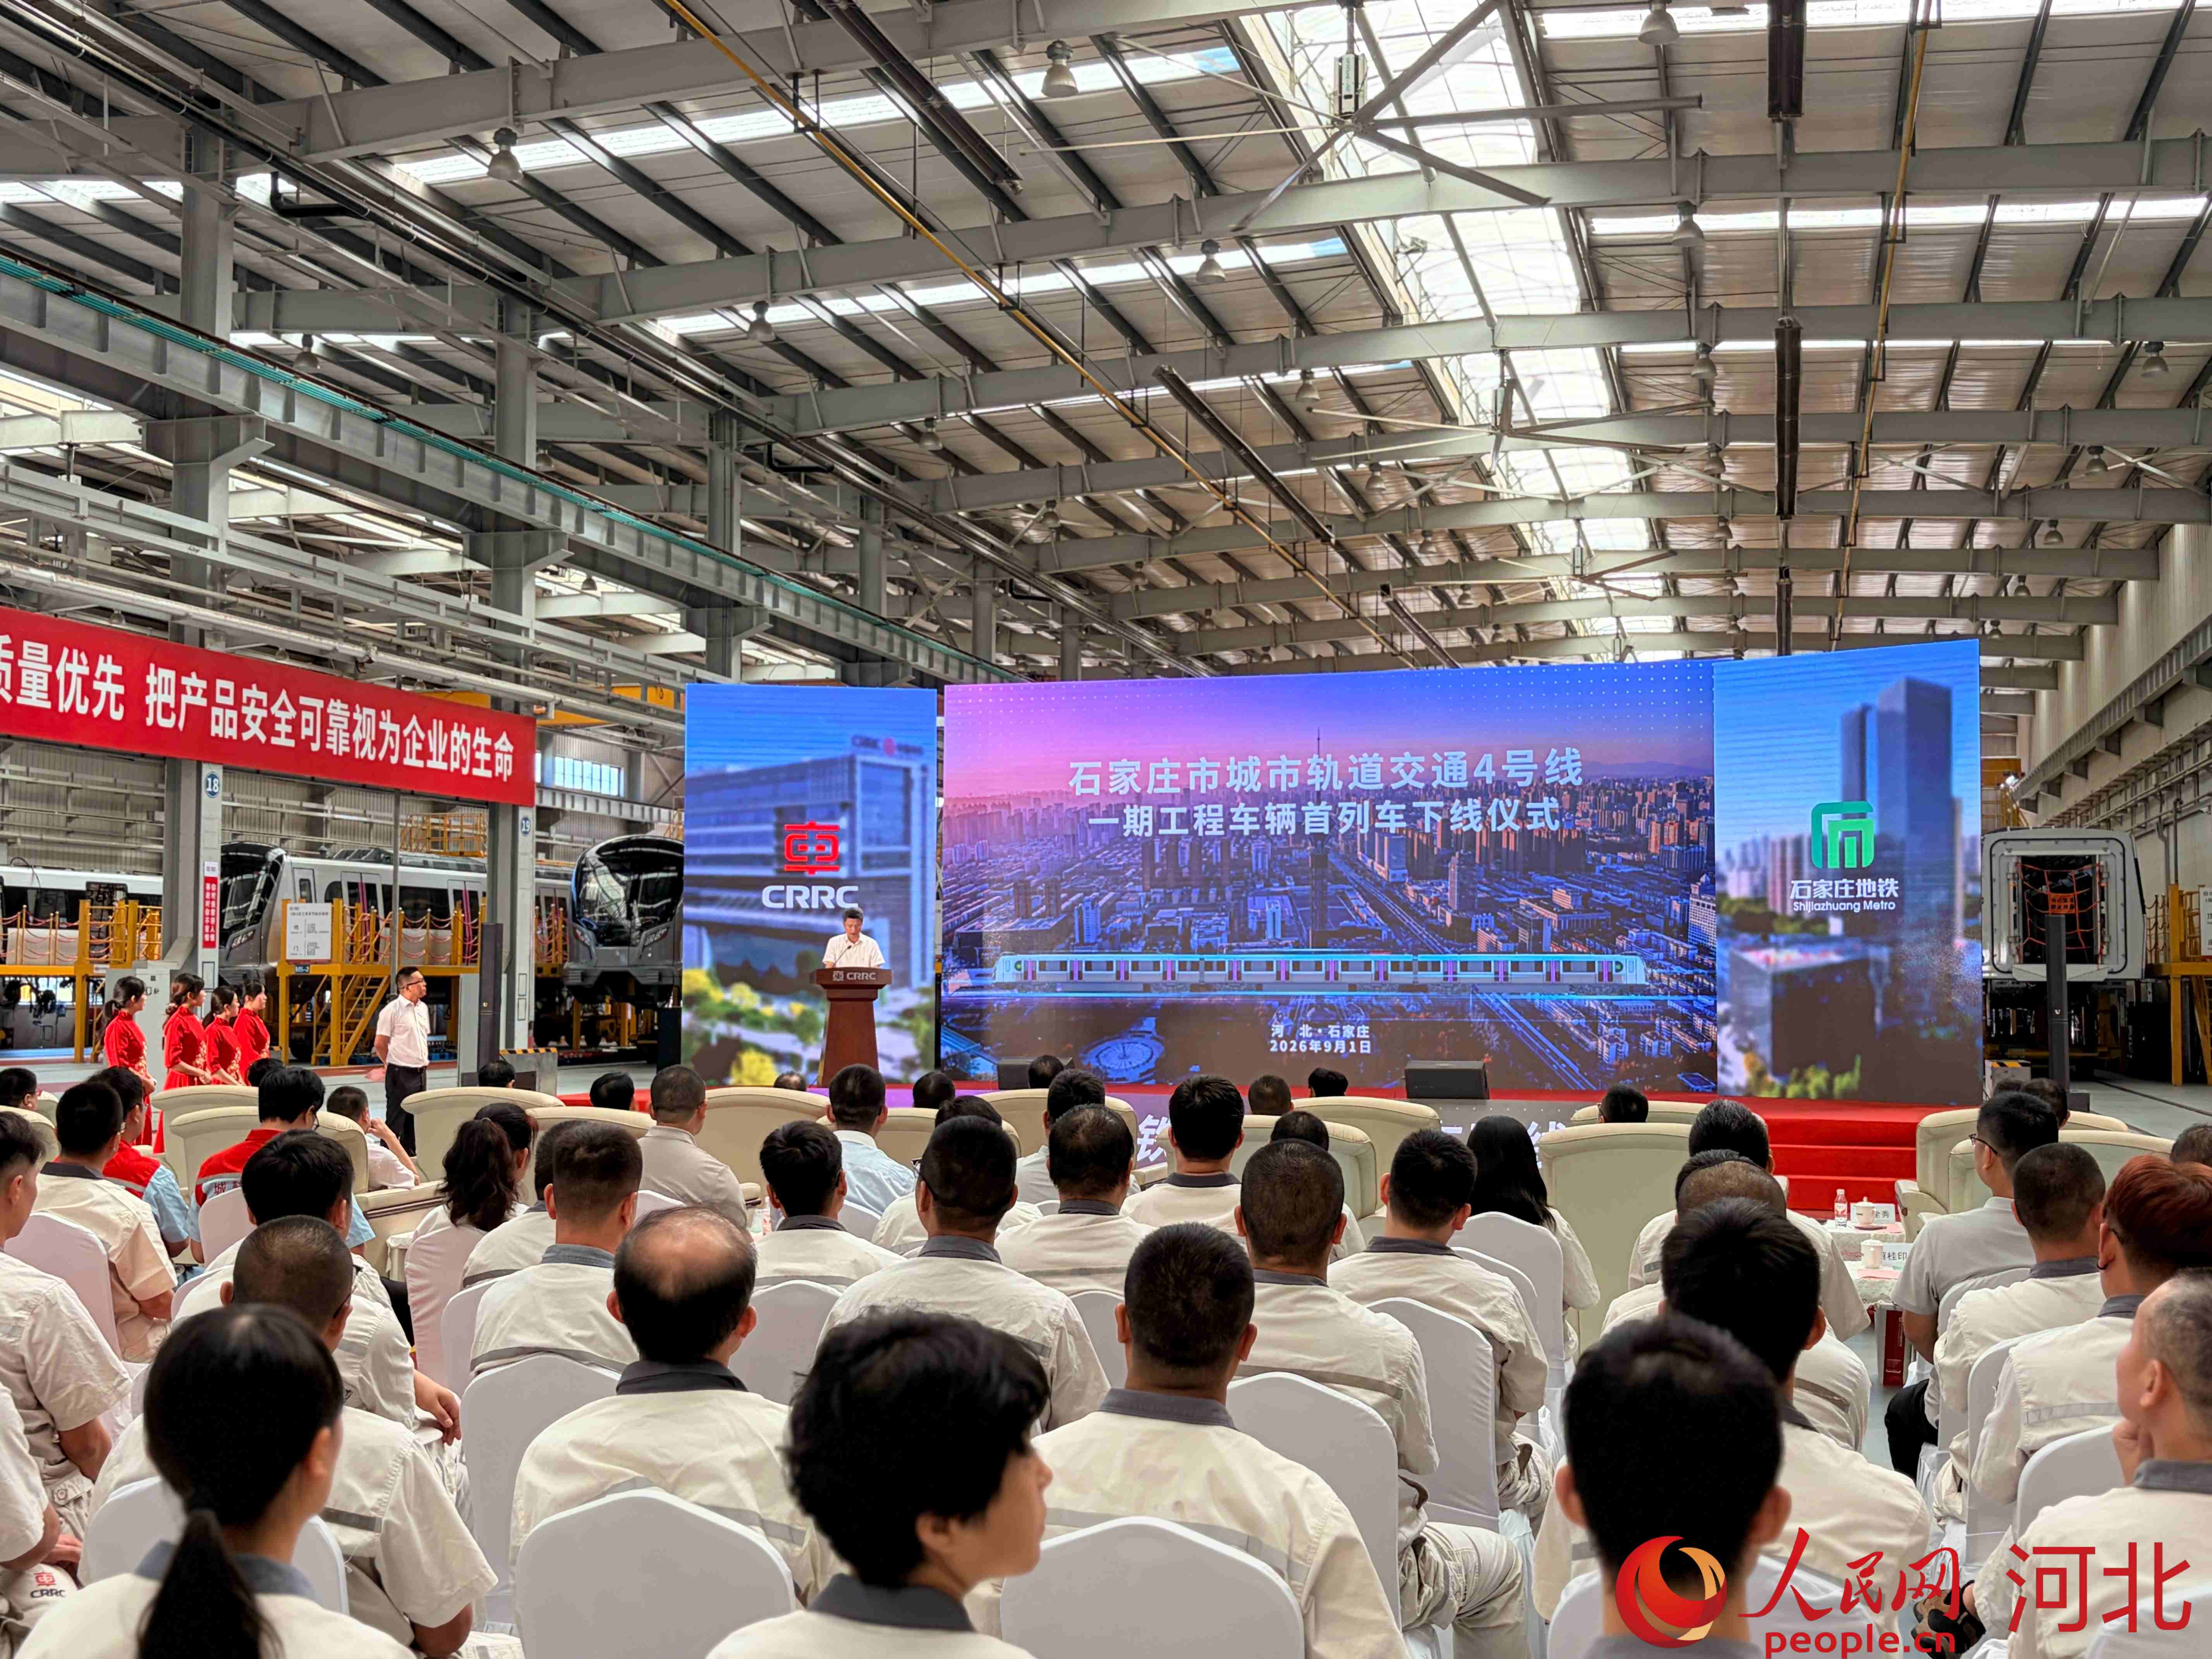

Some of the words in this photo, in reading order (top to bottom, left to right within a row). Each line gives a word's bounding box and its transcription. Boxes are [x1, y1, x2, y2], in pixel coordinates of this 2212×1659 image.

[145, 662, 514, 782] 把产品安全可靠视为企业的生命
[1068, 747, 1582, 796] 石家庄市城市轨道交通4号线
[206, 778, 219, 793] 18
[522, 820, 530, 831] 19
[1089, 797, 1559, 837] 一期工程车辆首列车下线仪式
[762, 885, 859, 909] CRRC
[1790, 878, 1899, 899] 石家庄地铁
[1793, 900, 1860, 913] Shijiazhuang
[1863, 900, 1896, 910] Metro
[1270, 1039, 1370, 1053] 2026年9月1日
[30, 1589, 66, 1598] CRRC
